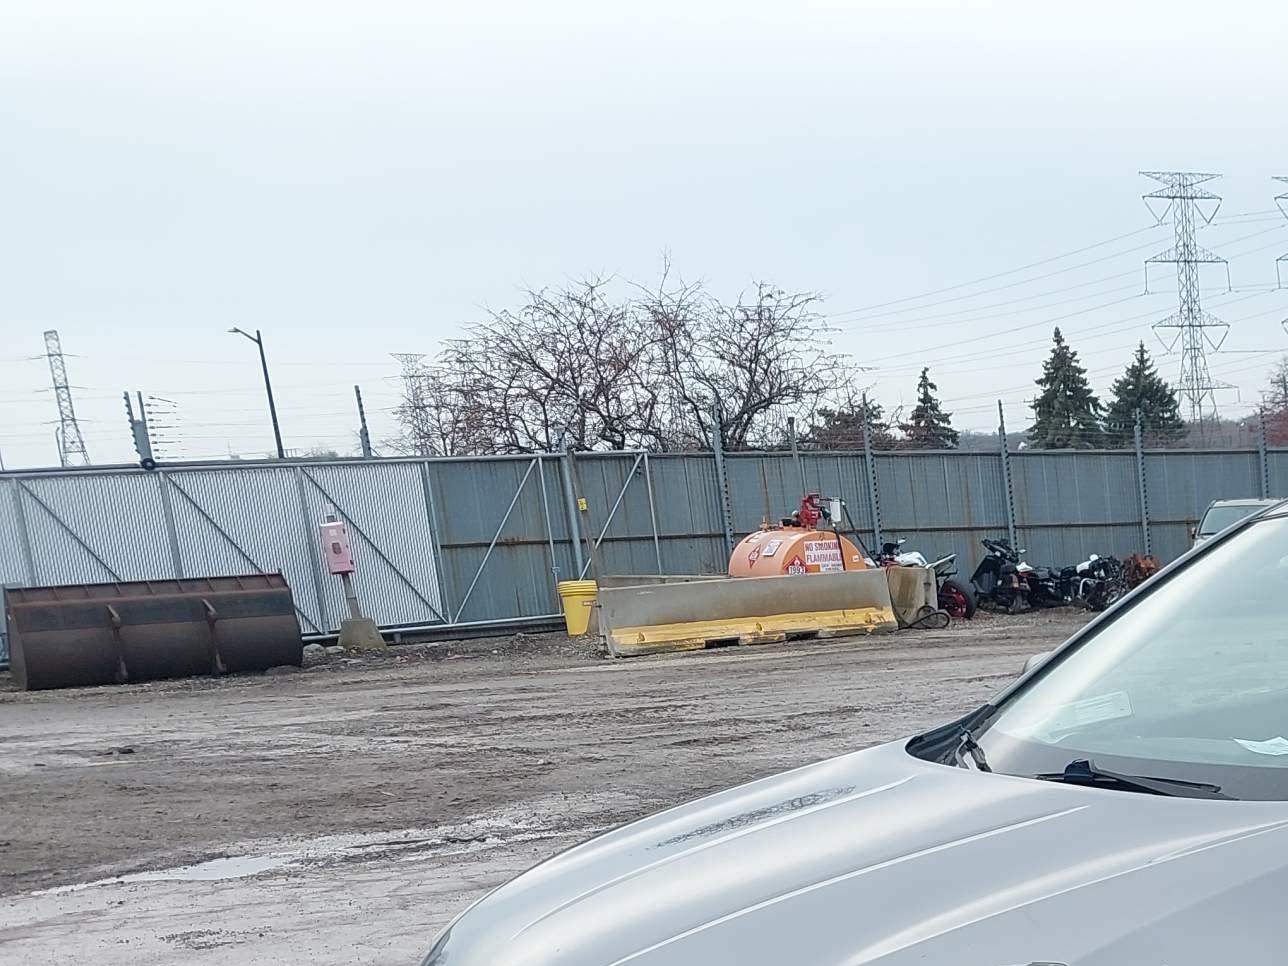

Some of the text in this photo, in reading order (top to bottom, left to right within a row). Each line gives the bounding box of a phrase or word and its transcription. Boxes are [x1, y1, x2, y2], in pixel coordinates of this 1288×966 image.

[805, 541, 839, 552] NO SMOKIN
[806, 552, 842, 563] FLAMMABL
